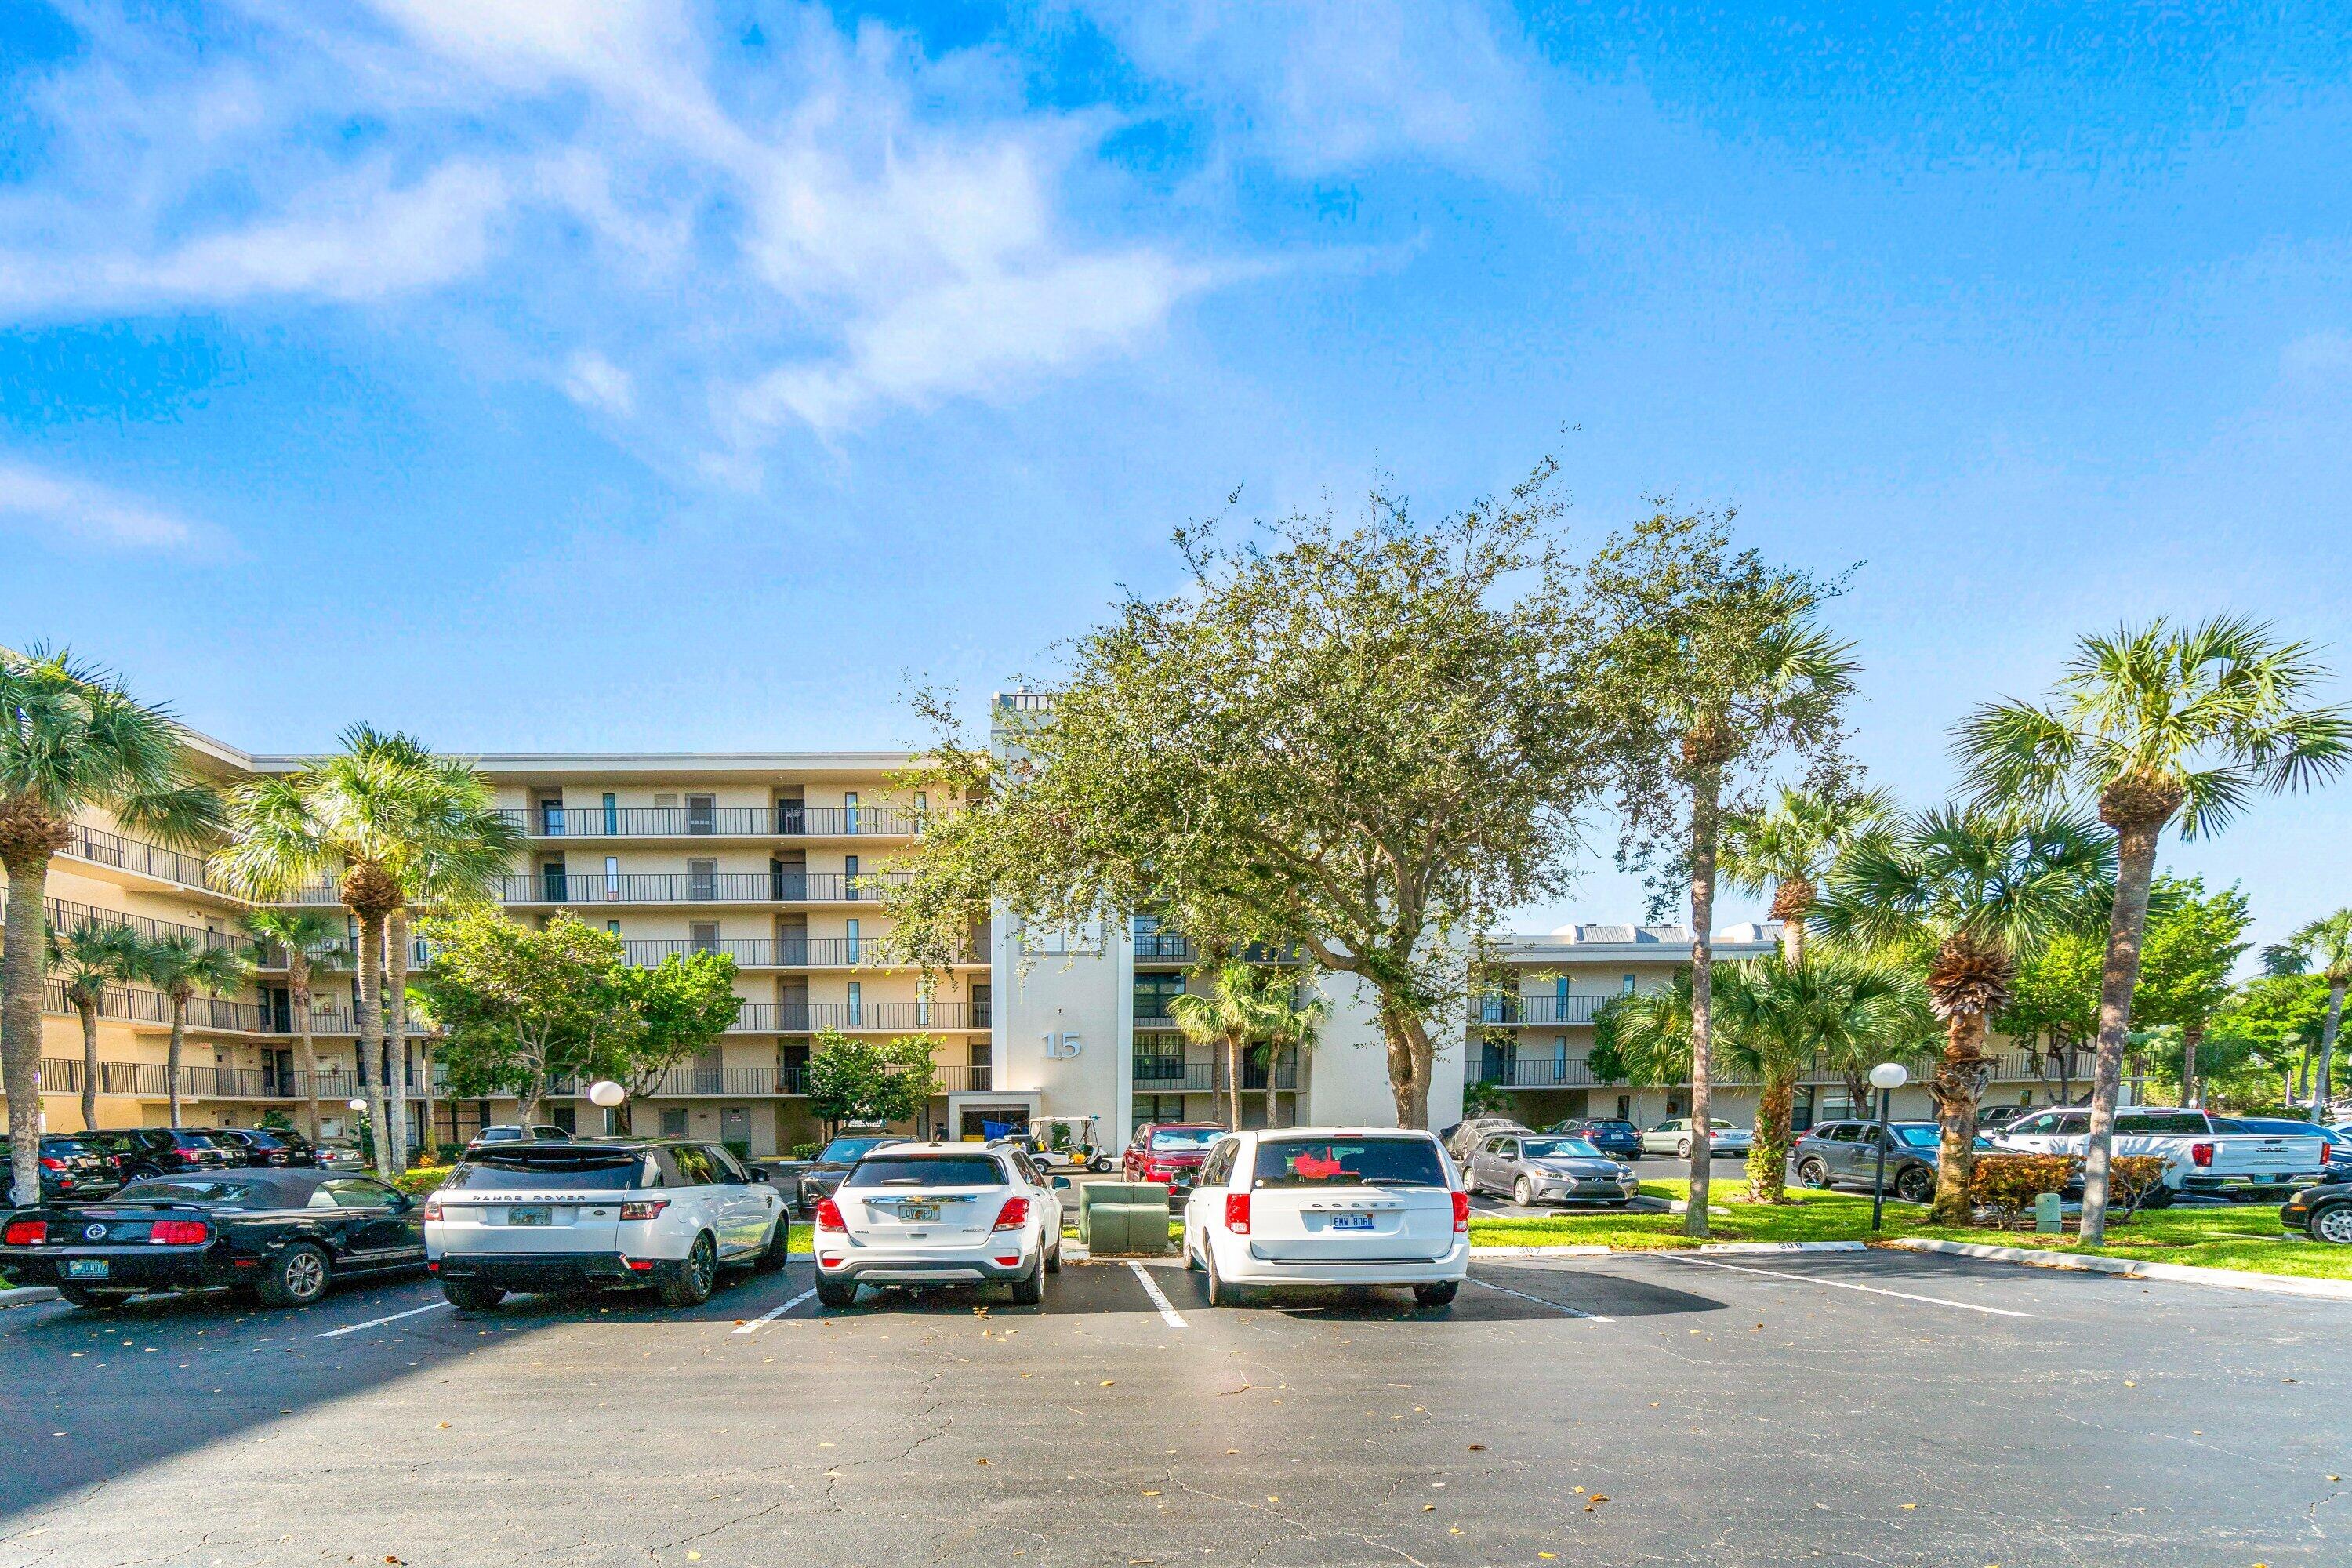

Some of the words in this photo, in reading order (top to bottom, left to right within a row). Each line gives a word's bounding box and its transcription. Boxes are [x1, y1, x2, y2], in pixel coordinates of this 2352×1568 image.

[1040, 1031, 1081, 1058] 15
[1334, 1218, 1348, 1226] EMW
[1353, 1217, 1373, 1226] 8060
